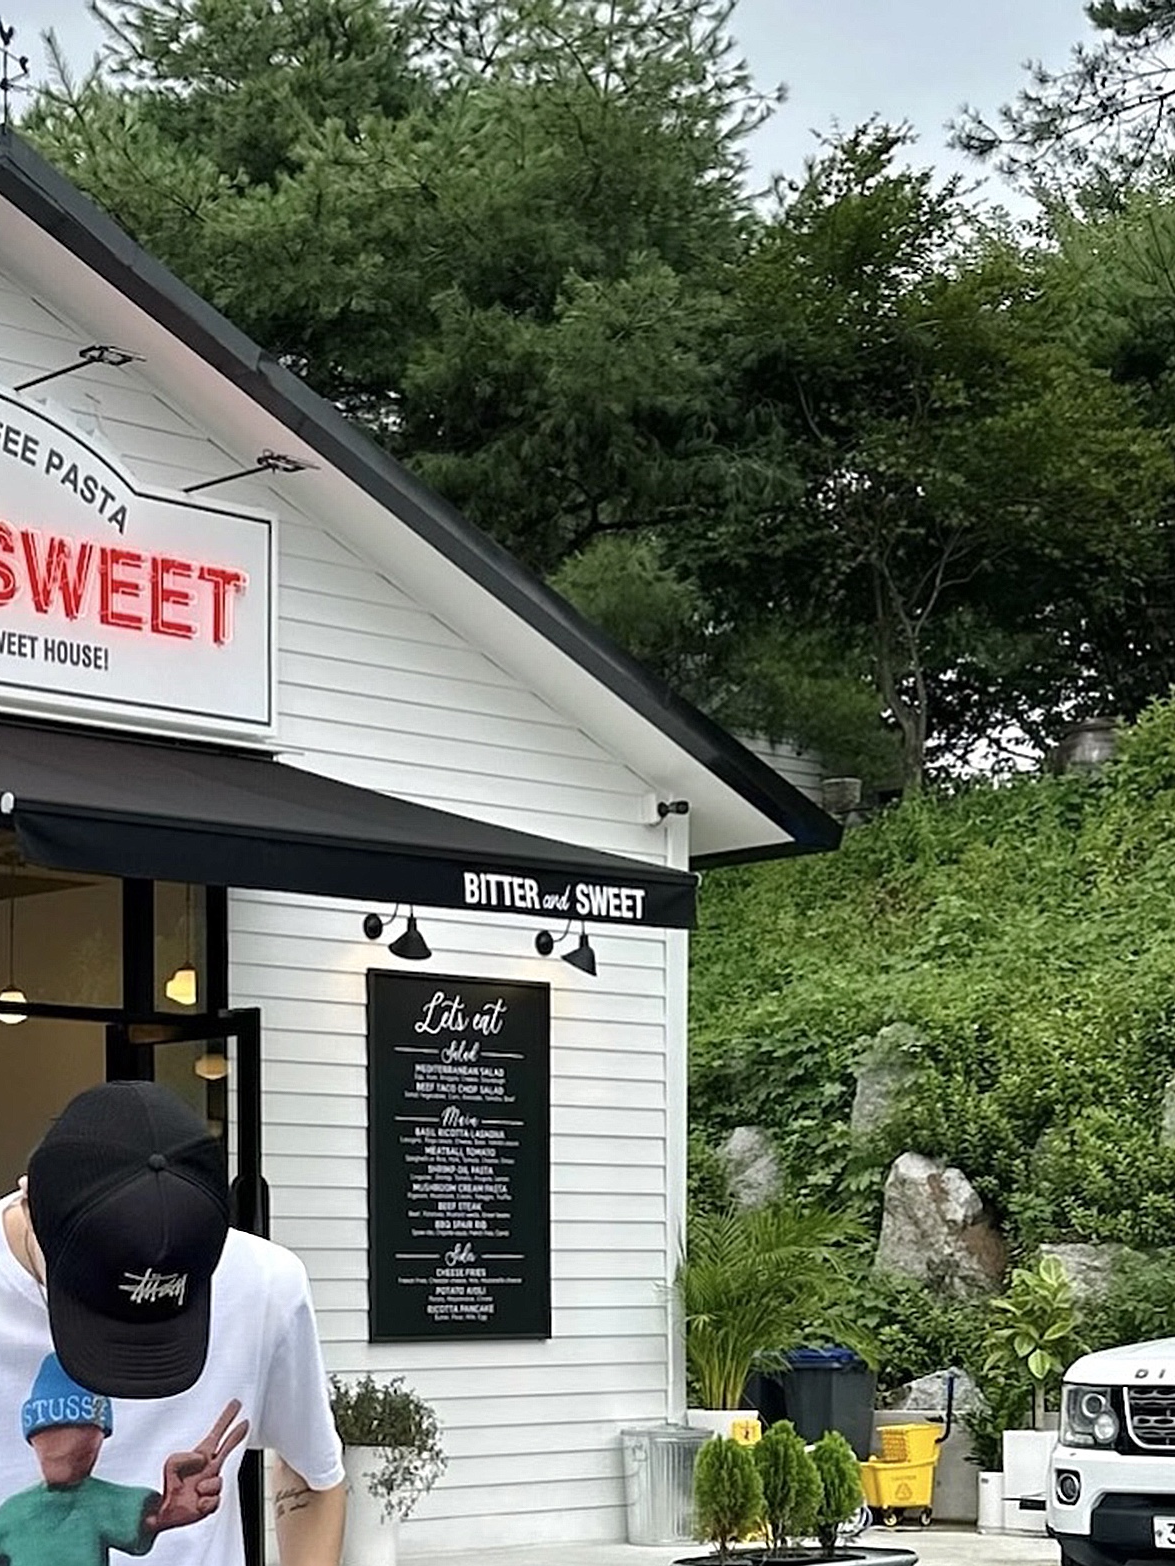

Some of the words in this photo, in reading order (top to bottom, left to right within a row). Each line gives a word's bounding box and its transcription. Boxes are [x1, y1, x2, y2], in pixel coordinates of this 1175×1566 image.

[43, 445, 129, 535] PASTA
[42, 627, 110, 671] HOUSE!
[463, 872, 541, 910] BITTER
[542, 884, 572, 911] and
[575, 883, 646, 920] SWEET
